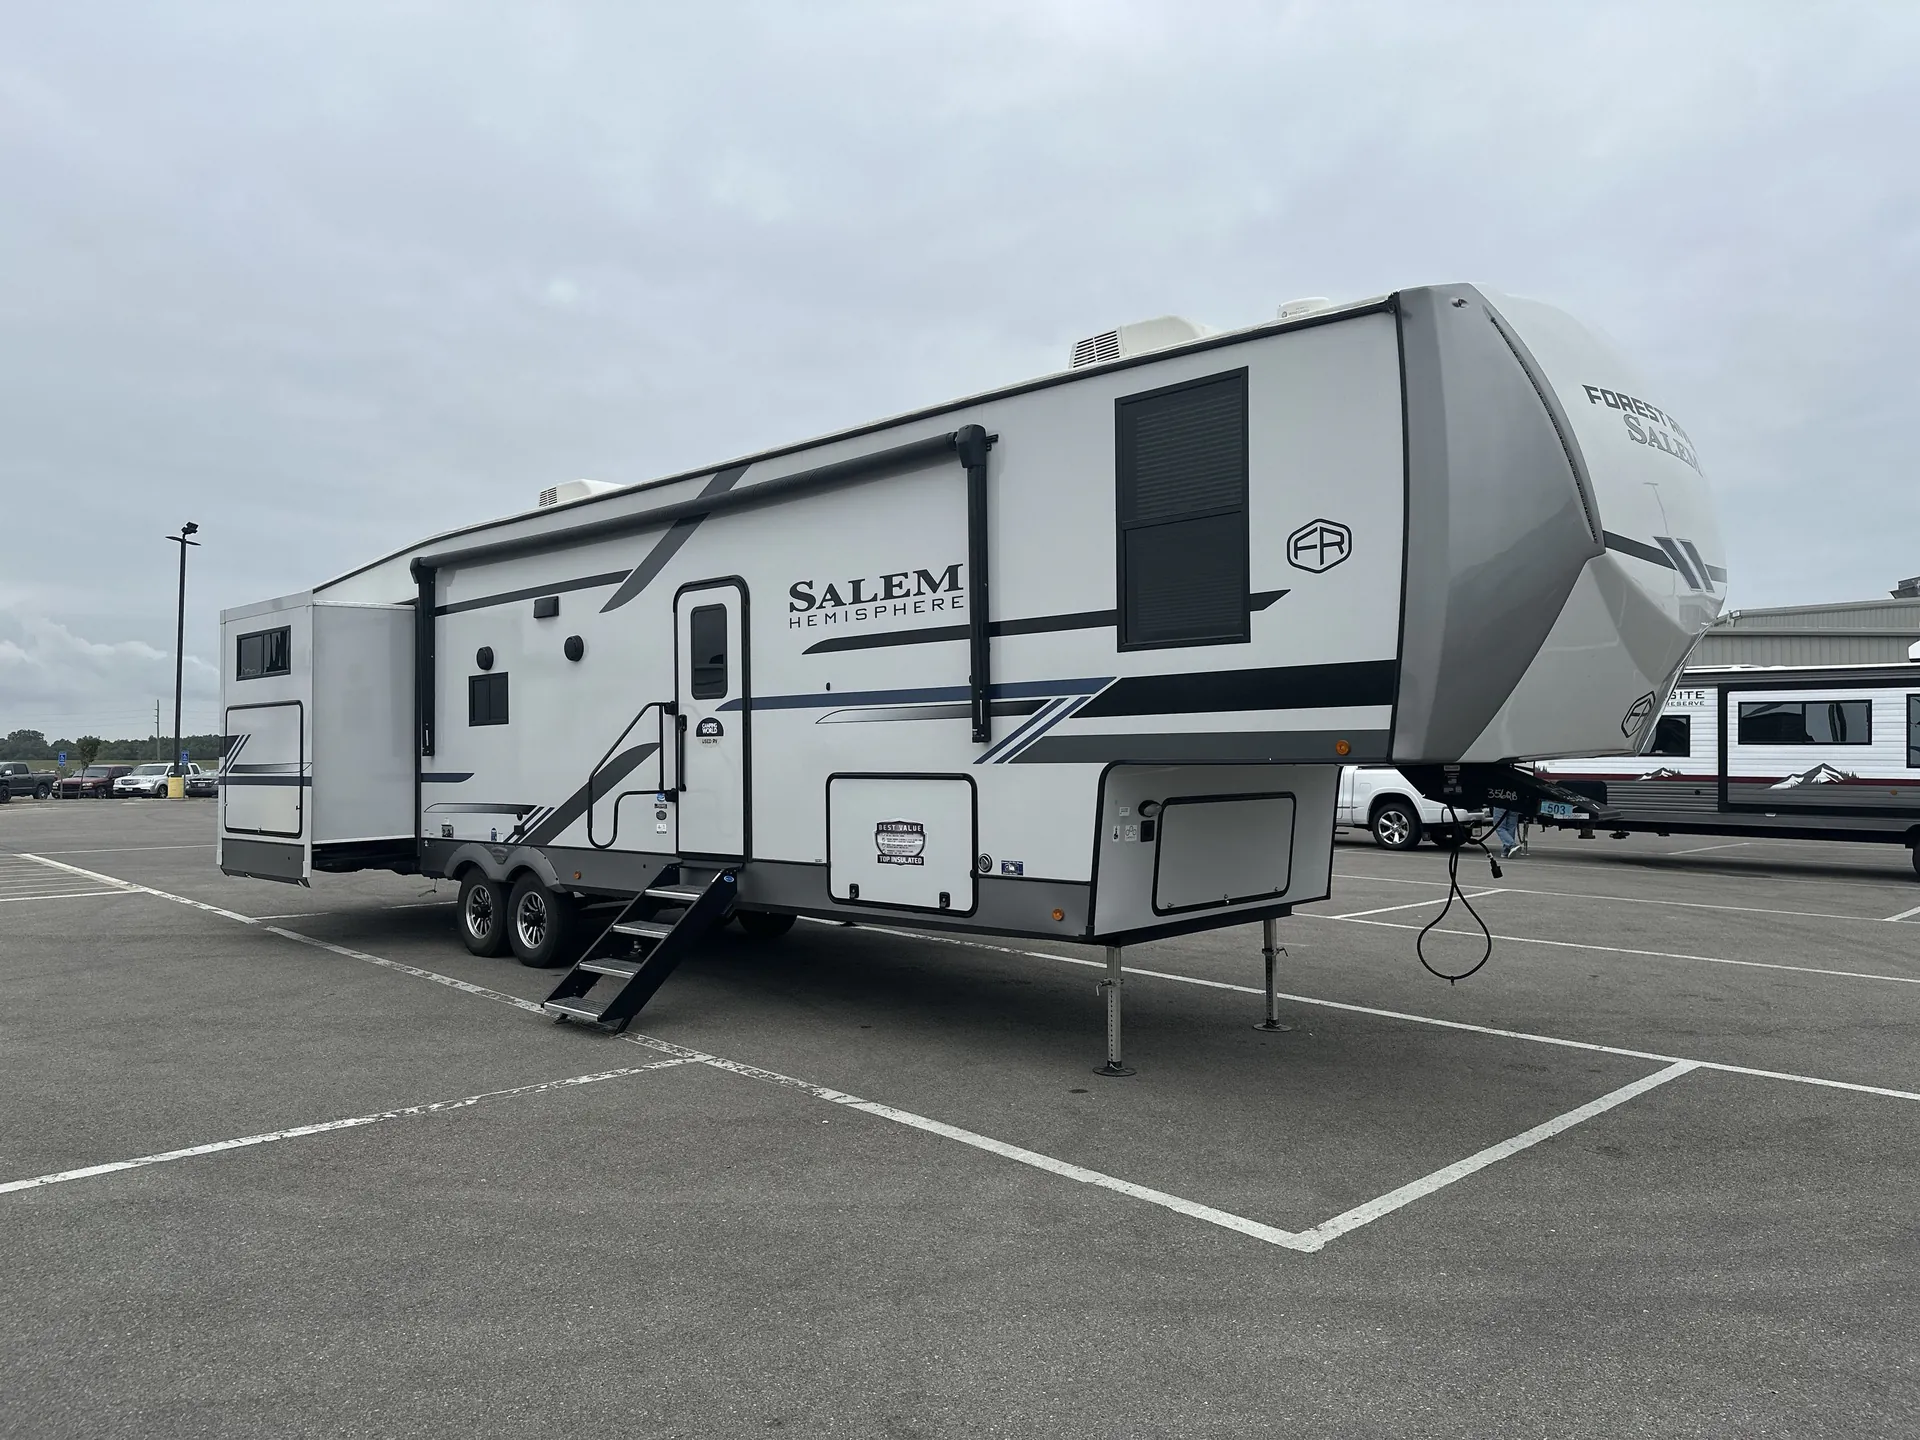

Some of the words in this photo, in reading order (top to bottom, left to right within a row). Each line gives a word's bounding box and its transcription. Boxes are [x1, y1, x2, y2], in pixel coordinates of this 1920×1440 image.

[1581, 384, 1667, 427] FOREST
[789, 563, 964, 613] SALEM
[789, 595, 964, 629] HEMISPHERE
[1547, 803, 1566, 815] 503
